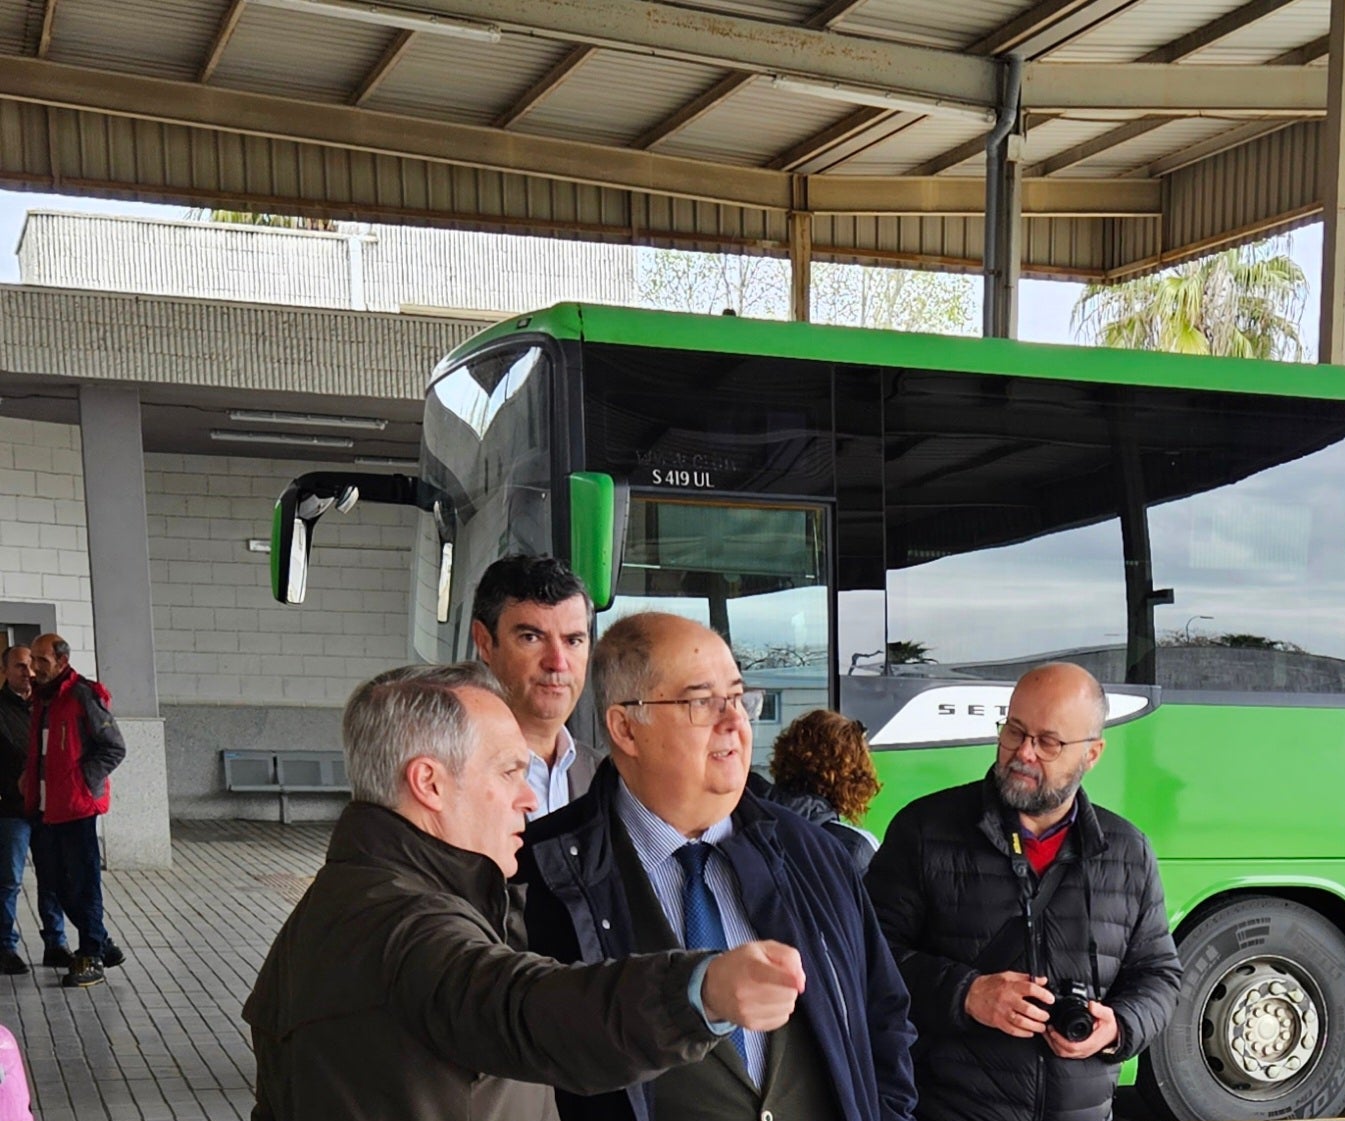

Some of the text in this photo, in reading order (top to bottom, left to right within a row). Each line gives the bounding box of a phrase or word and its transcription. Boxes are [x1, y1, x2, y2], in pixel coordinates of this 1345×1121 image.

[652, 468, 715, 488] S 419 UL
[938, 704, 1009, 716] SET
